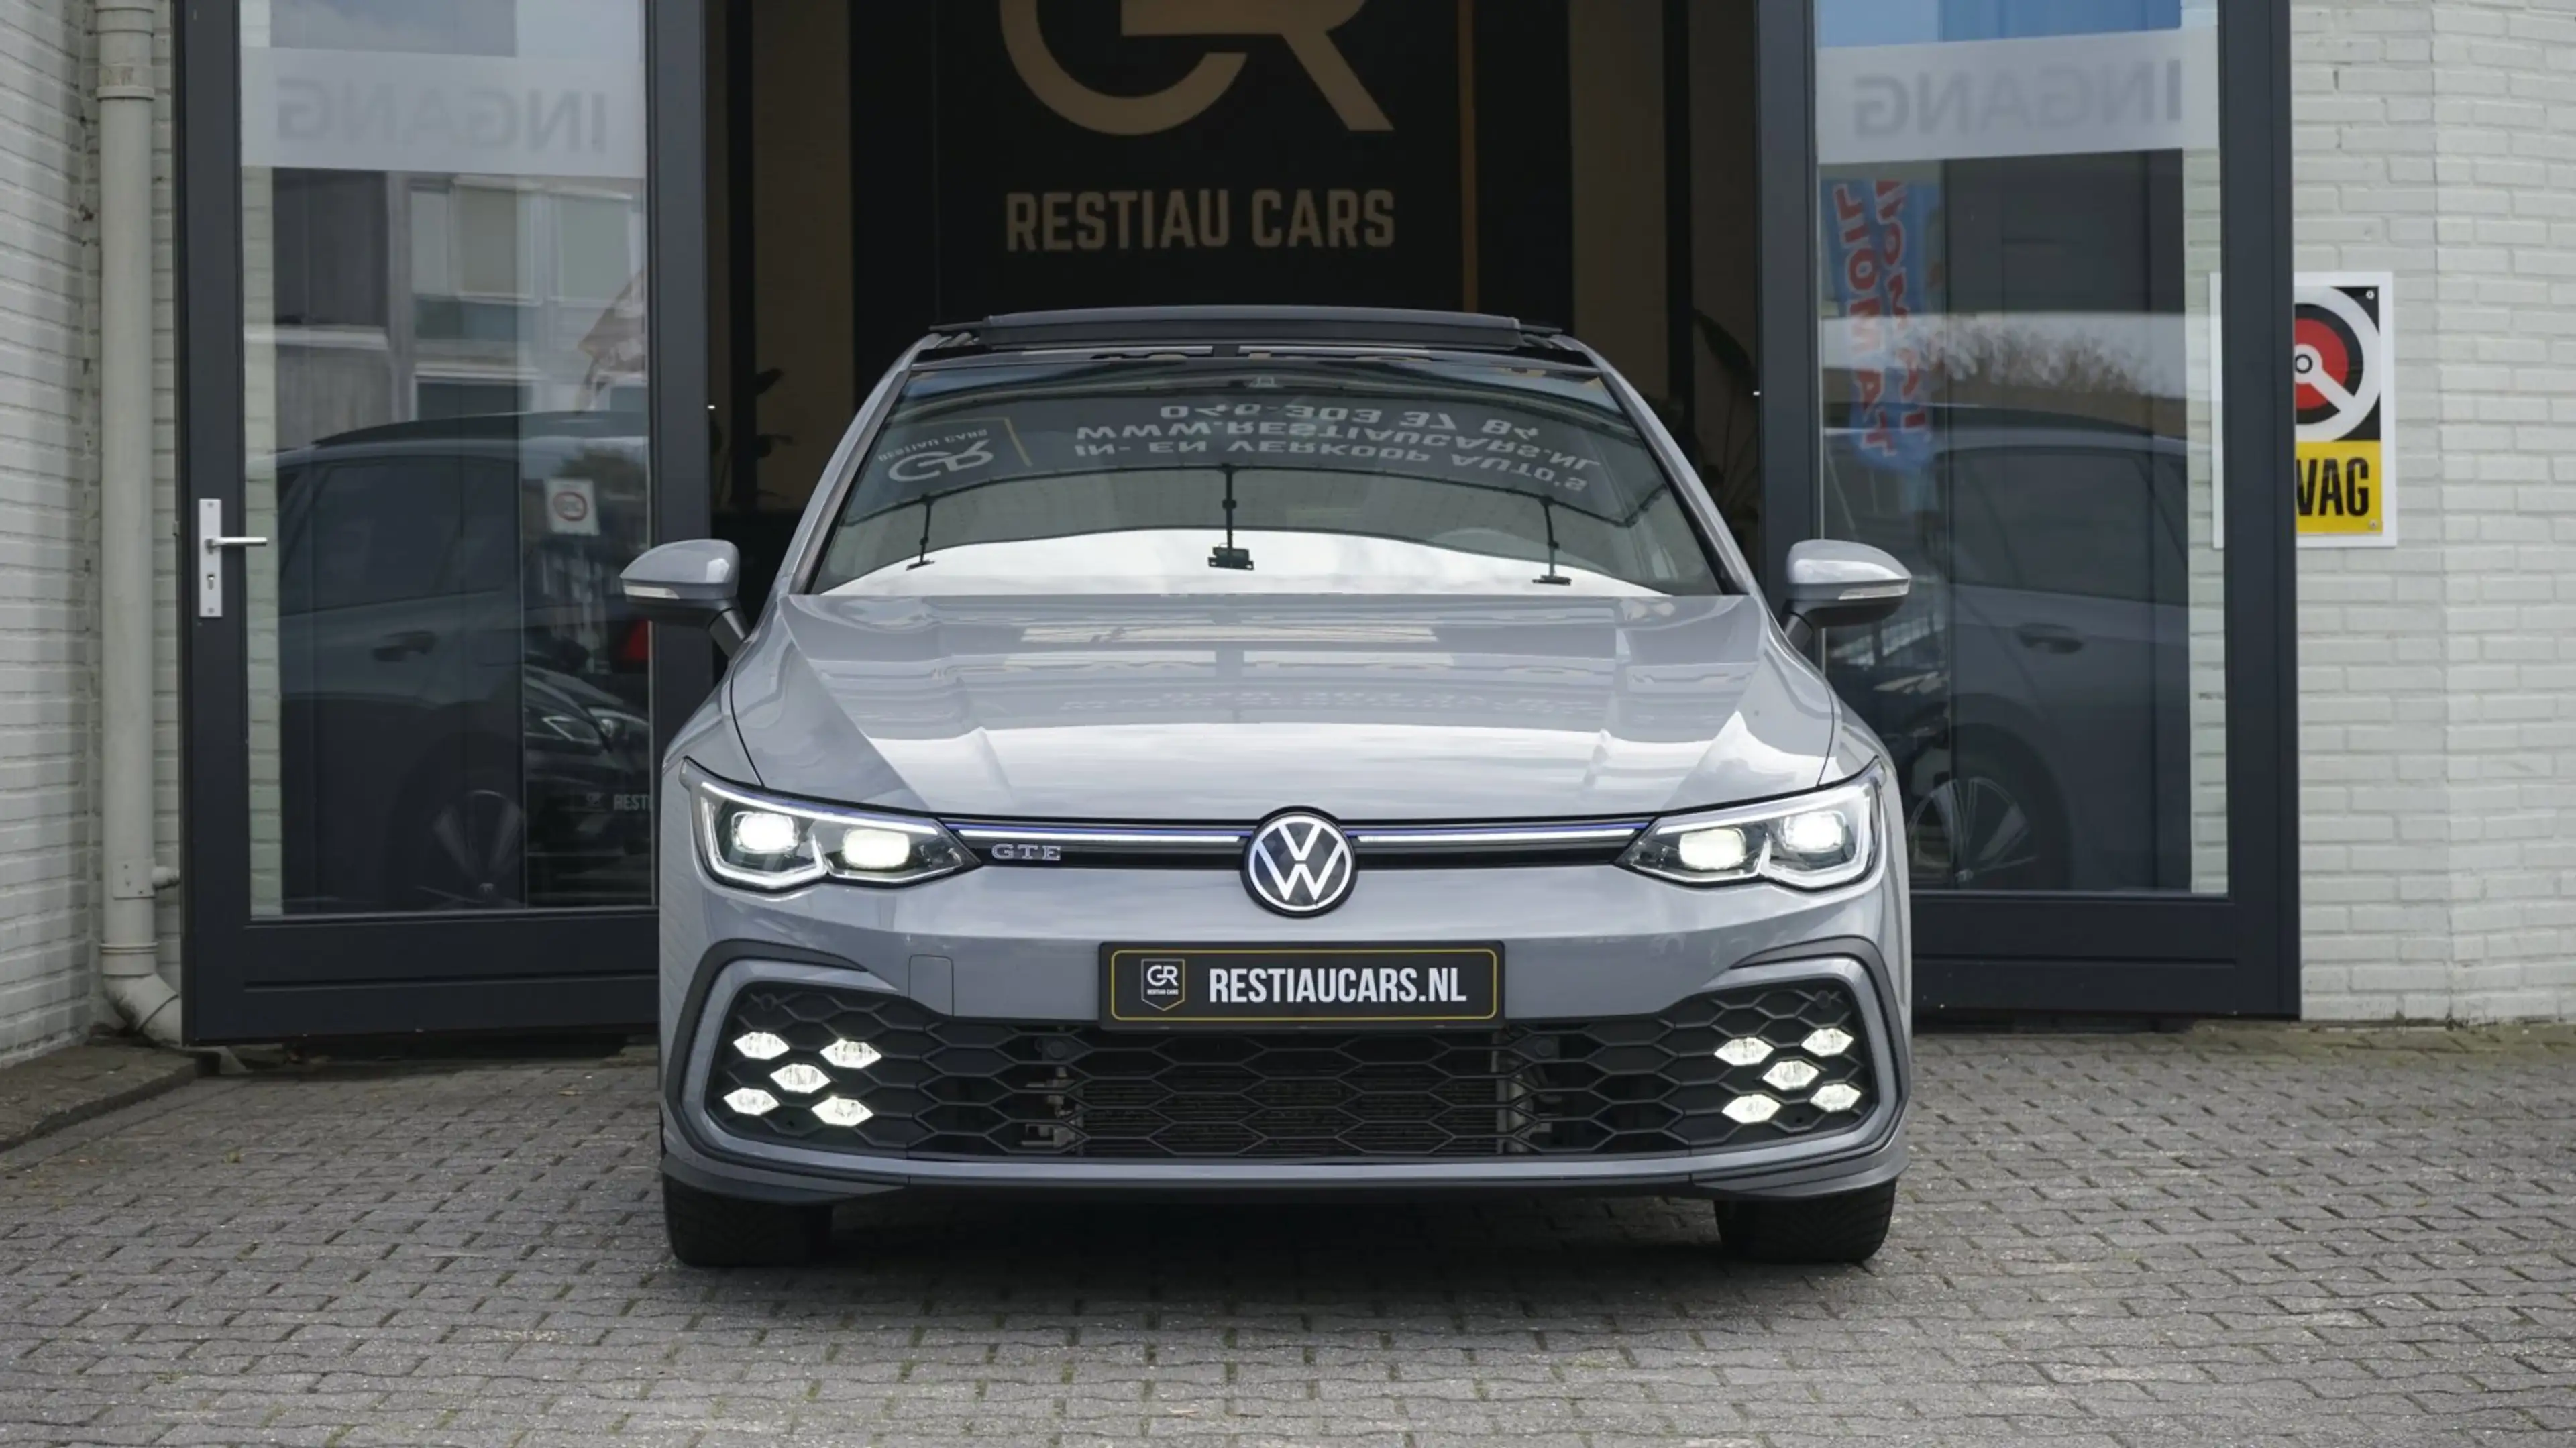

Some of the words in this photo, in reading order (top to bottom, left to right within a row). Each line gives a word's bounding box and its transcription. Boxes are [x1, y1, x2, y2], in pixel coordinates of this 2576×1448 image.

[1007, 190, 1230, 252] RESTIAU
[1252, 189, 1395, 248] CARS
[991, 843, 1062, 861] GTE
[1147, 964, 1179, 987] GR
[1209, 967, 1467, 1003] RESTIAUCARS.NL
